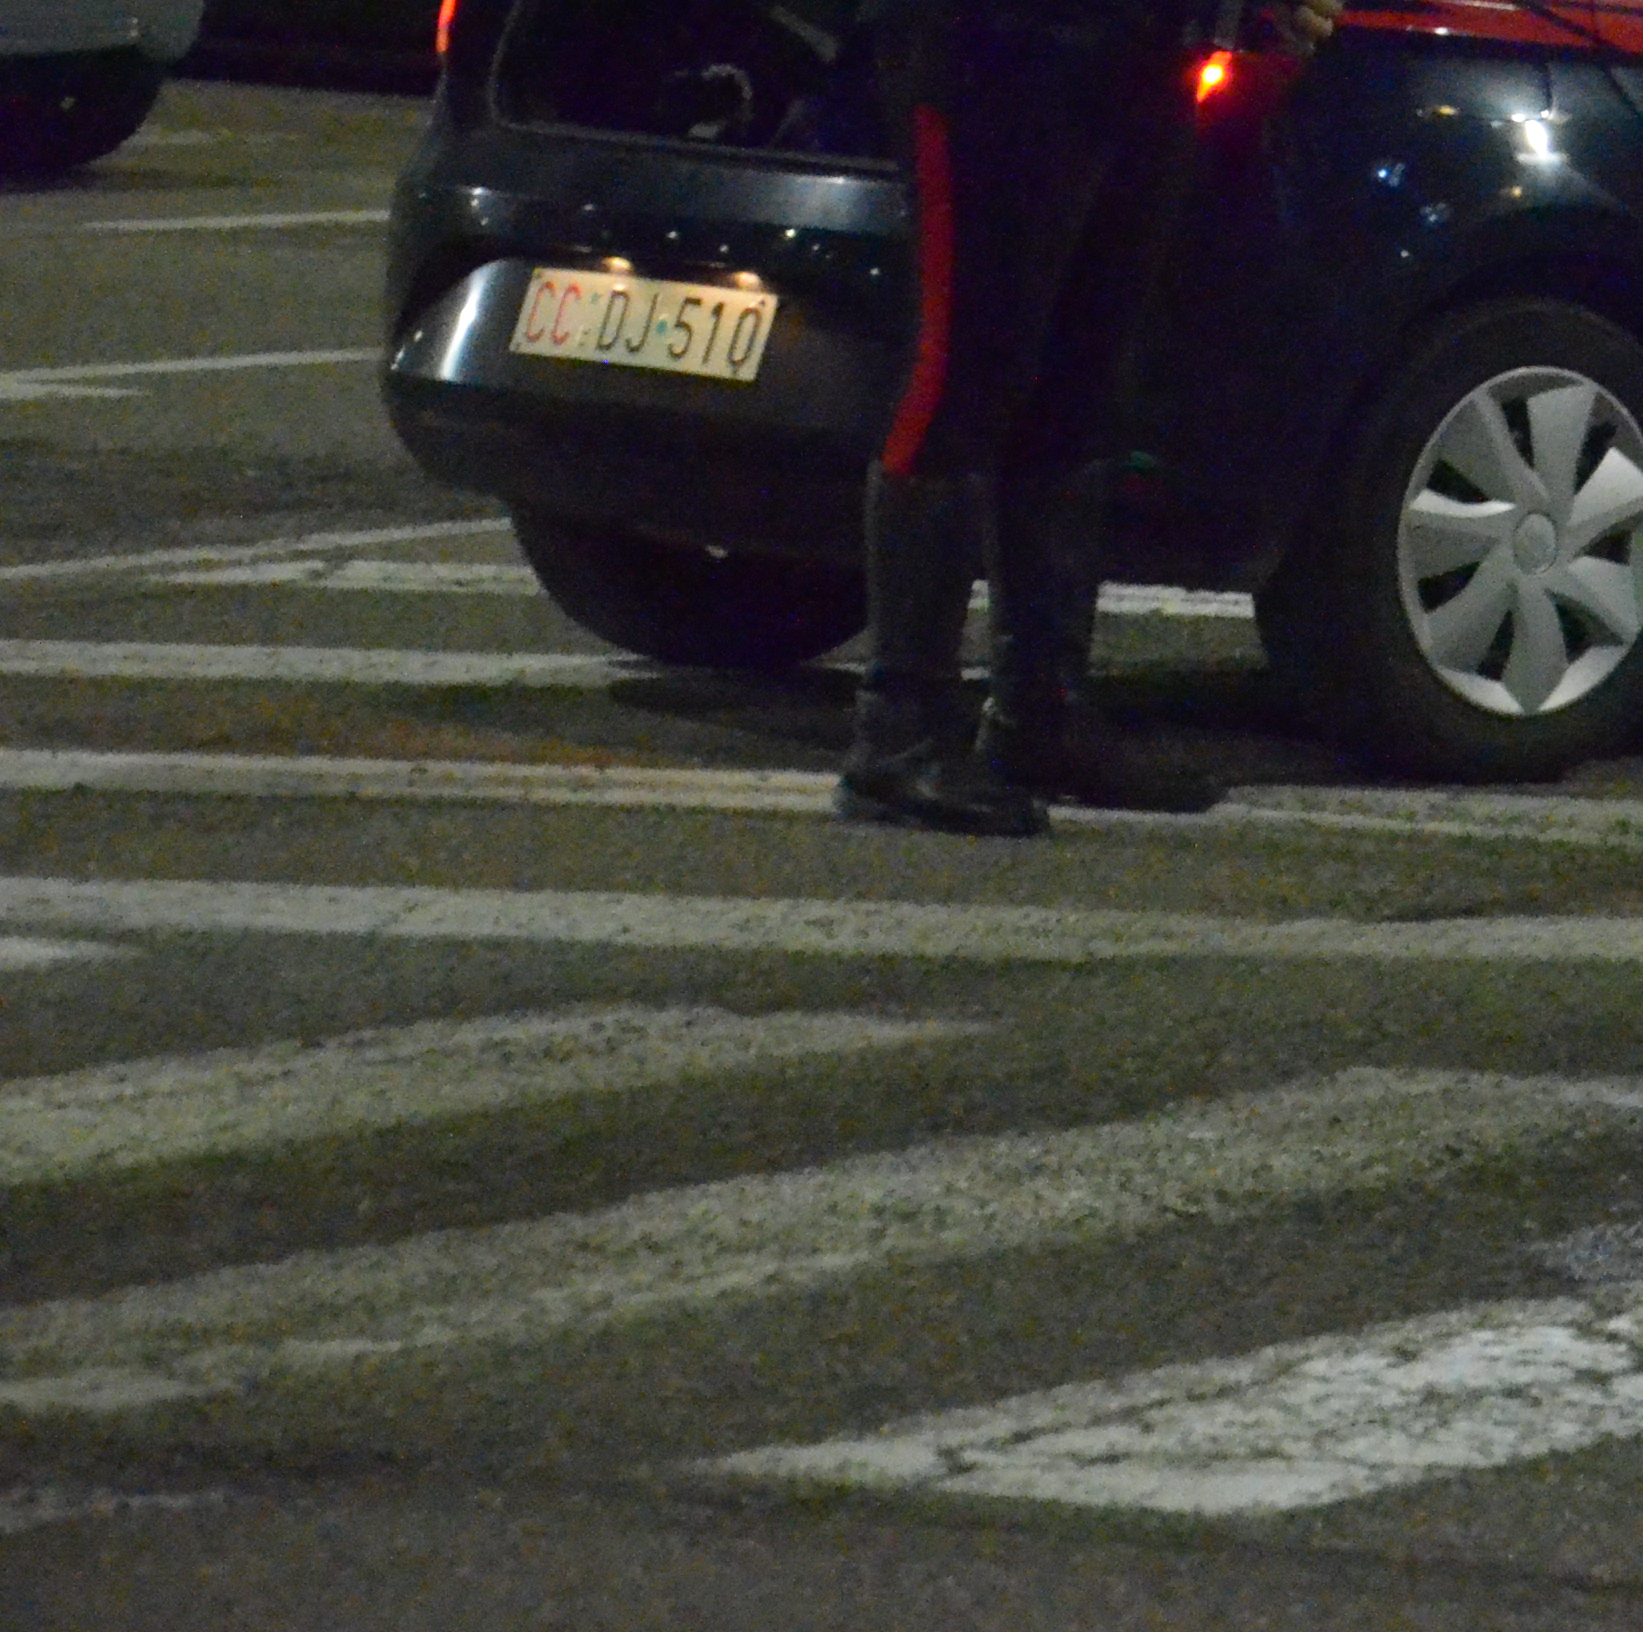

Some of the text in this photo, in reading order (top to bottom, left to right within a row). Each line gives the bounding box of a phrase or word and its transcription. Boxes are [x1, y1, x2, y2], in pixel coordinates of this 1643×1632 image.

[525, 280, 763, 367] CC DJ 510
